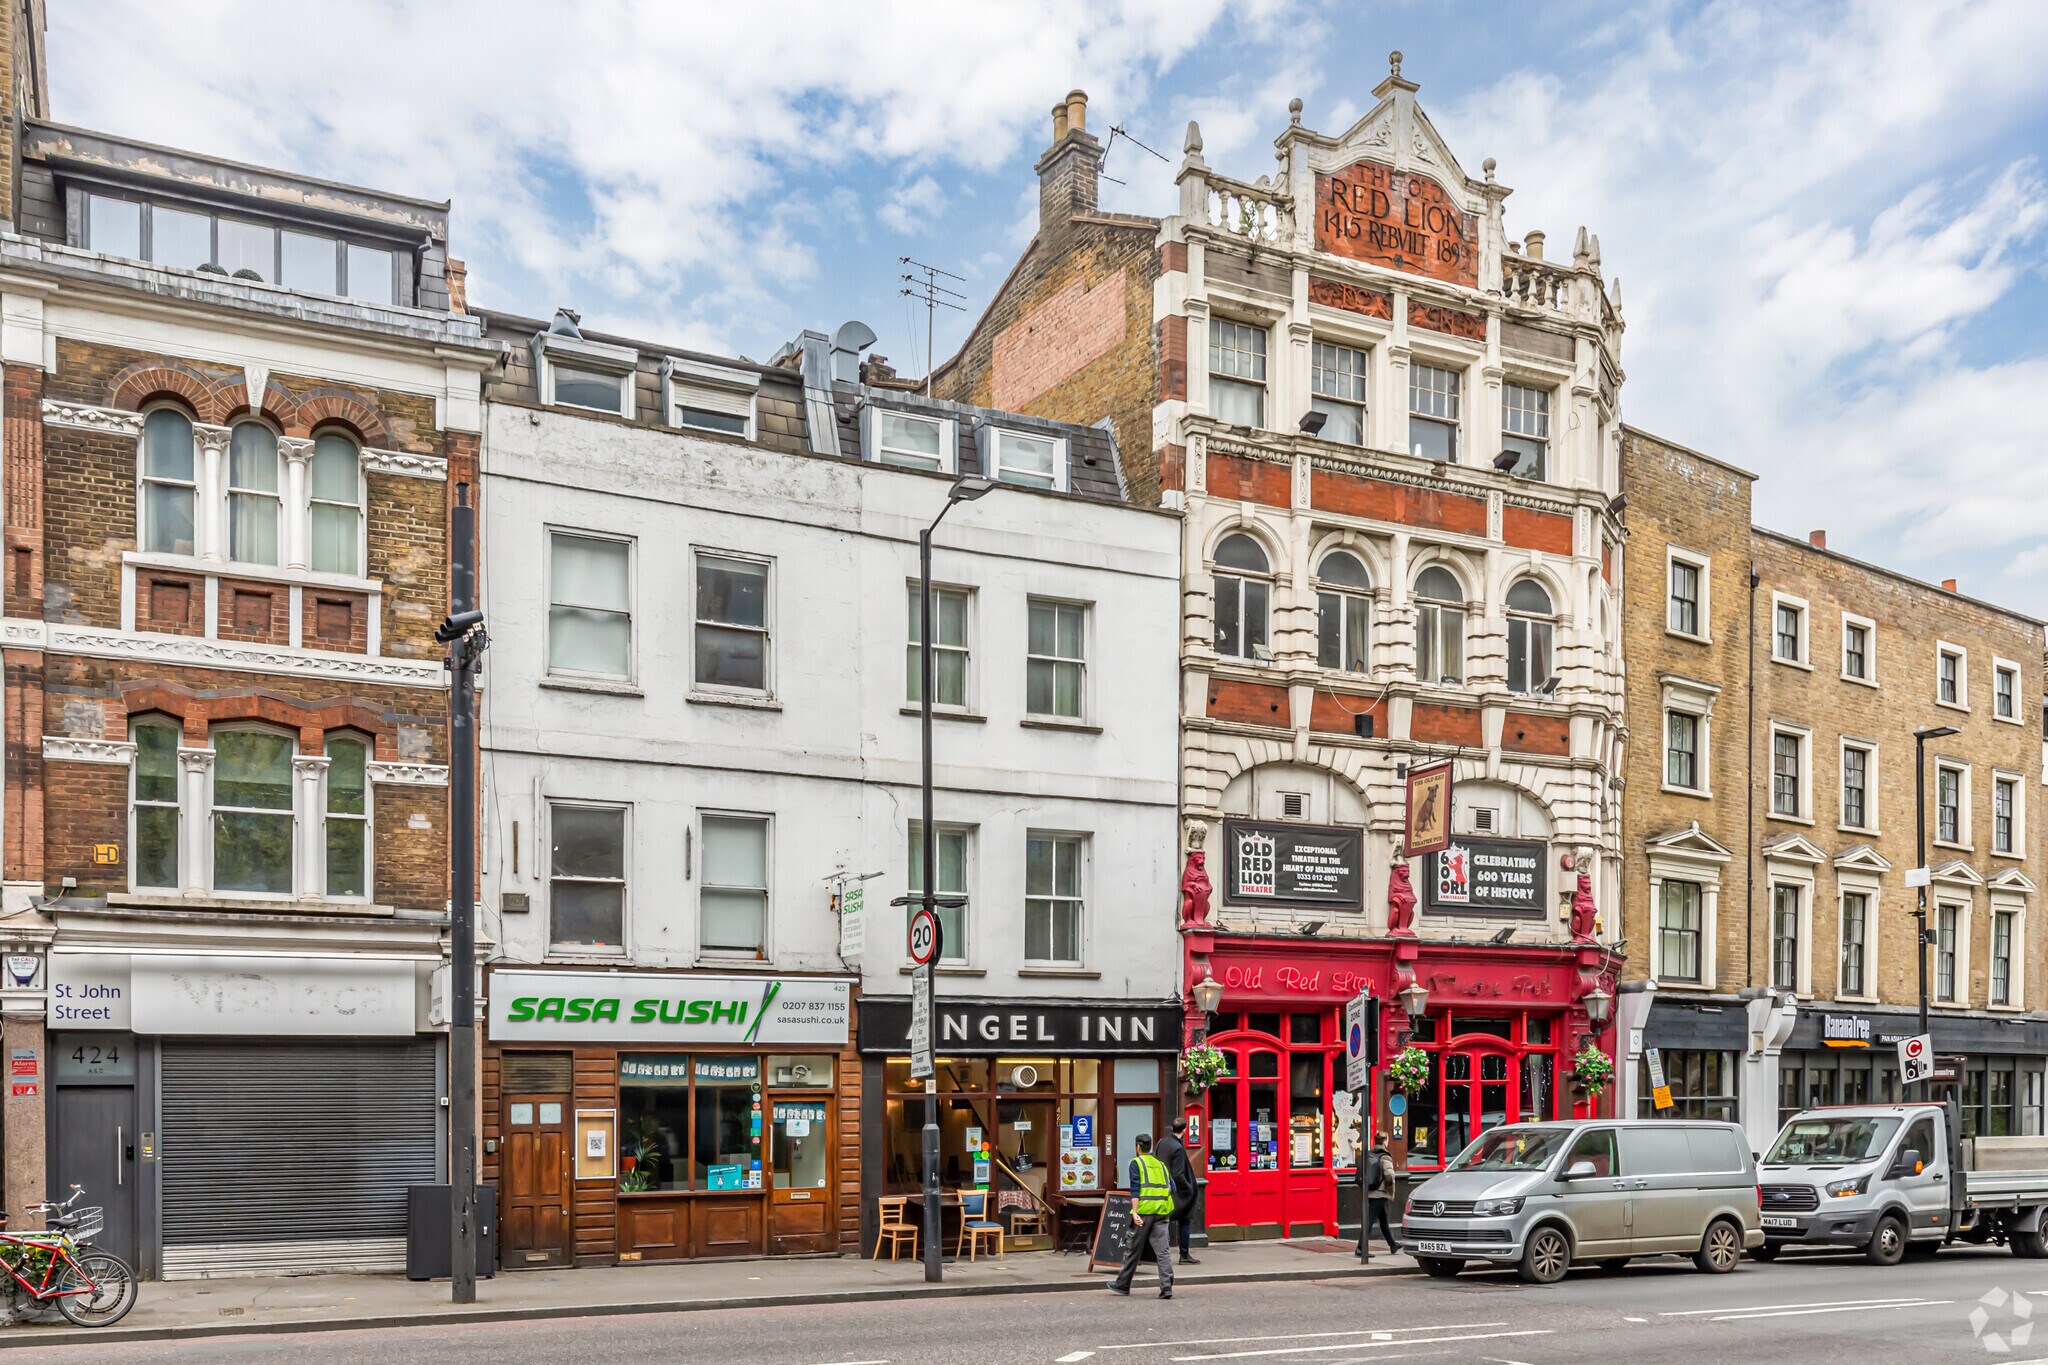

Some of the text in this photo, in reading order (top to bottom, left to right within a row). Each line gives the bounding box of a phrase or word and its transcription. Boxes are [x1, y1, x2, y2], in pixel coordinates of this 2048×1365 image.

[1355, 163, 1397, 191] THE
[1330, 177, 1473, 243] RED LION
[1324, 209, 1362, 239] 1415
[1424, 776, 1435, 784] OLD
[1434, 774, 1445, 782] RED
[1241, 841, 1272, 856] OLD
[1412, 835, 1443, 848] THEATRE PUB
[1294, 845, 1338, 855] EXCEPTIONAL
[1241, 857, 1272, 872] RED
[1291, 855, 1341, 865] THEATRE IN THE
[1473, 854, 1536, 869] CELEBRATING
[1282, 864, 1303, 873] HEART
[1315, 866, 1349, 875] ISLINGTON
[1241, 872, 1273, 885] LION
[1477, 871, 1533, 884] 600 YEARS
[844, 888, 863, 903] SASA
[1241, 885, 1273, 893] THEATRE
[1475, 886, 1535, 900] OF HISTORY
[843, 900, 864, 915] SUSHI
[913, 925, 931, 949] 20
[1225, 965, 1376, 992] Old Red Lion
[55, 984, 121, 999] St John
[55, 1004, 111, 1020] Street
[507, 997, 749, 1024] SASA SUSHI
[782, 1001, 846, 1011] 0207 837 1155
[777, 1015, 845, 1024] sasasushi.co.uk
[1350, 1009, 1361, 1022] ZONE
[905, 1014, 1055, 1042] NGEL
[1080, 1016, 1154, 1042] INN
[72, 1046, 120, 1064] 424
[1763, 1218, 1778, 1226] MA17
[1420, 1242, 1448, 1252] RA65 BZL
